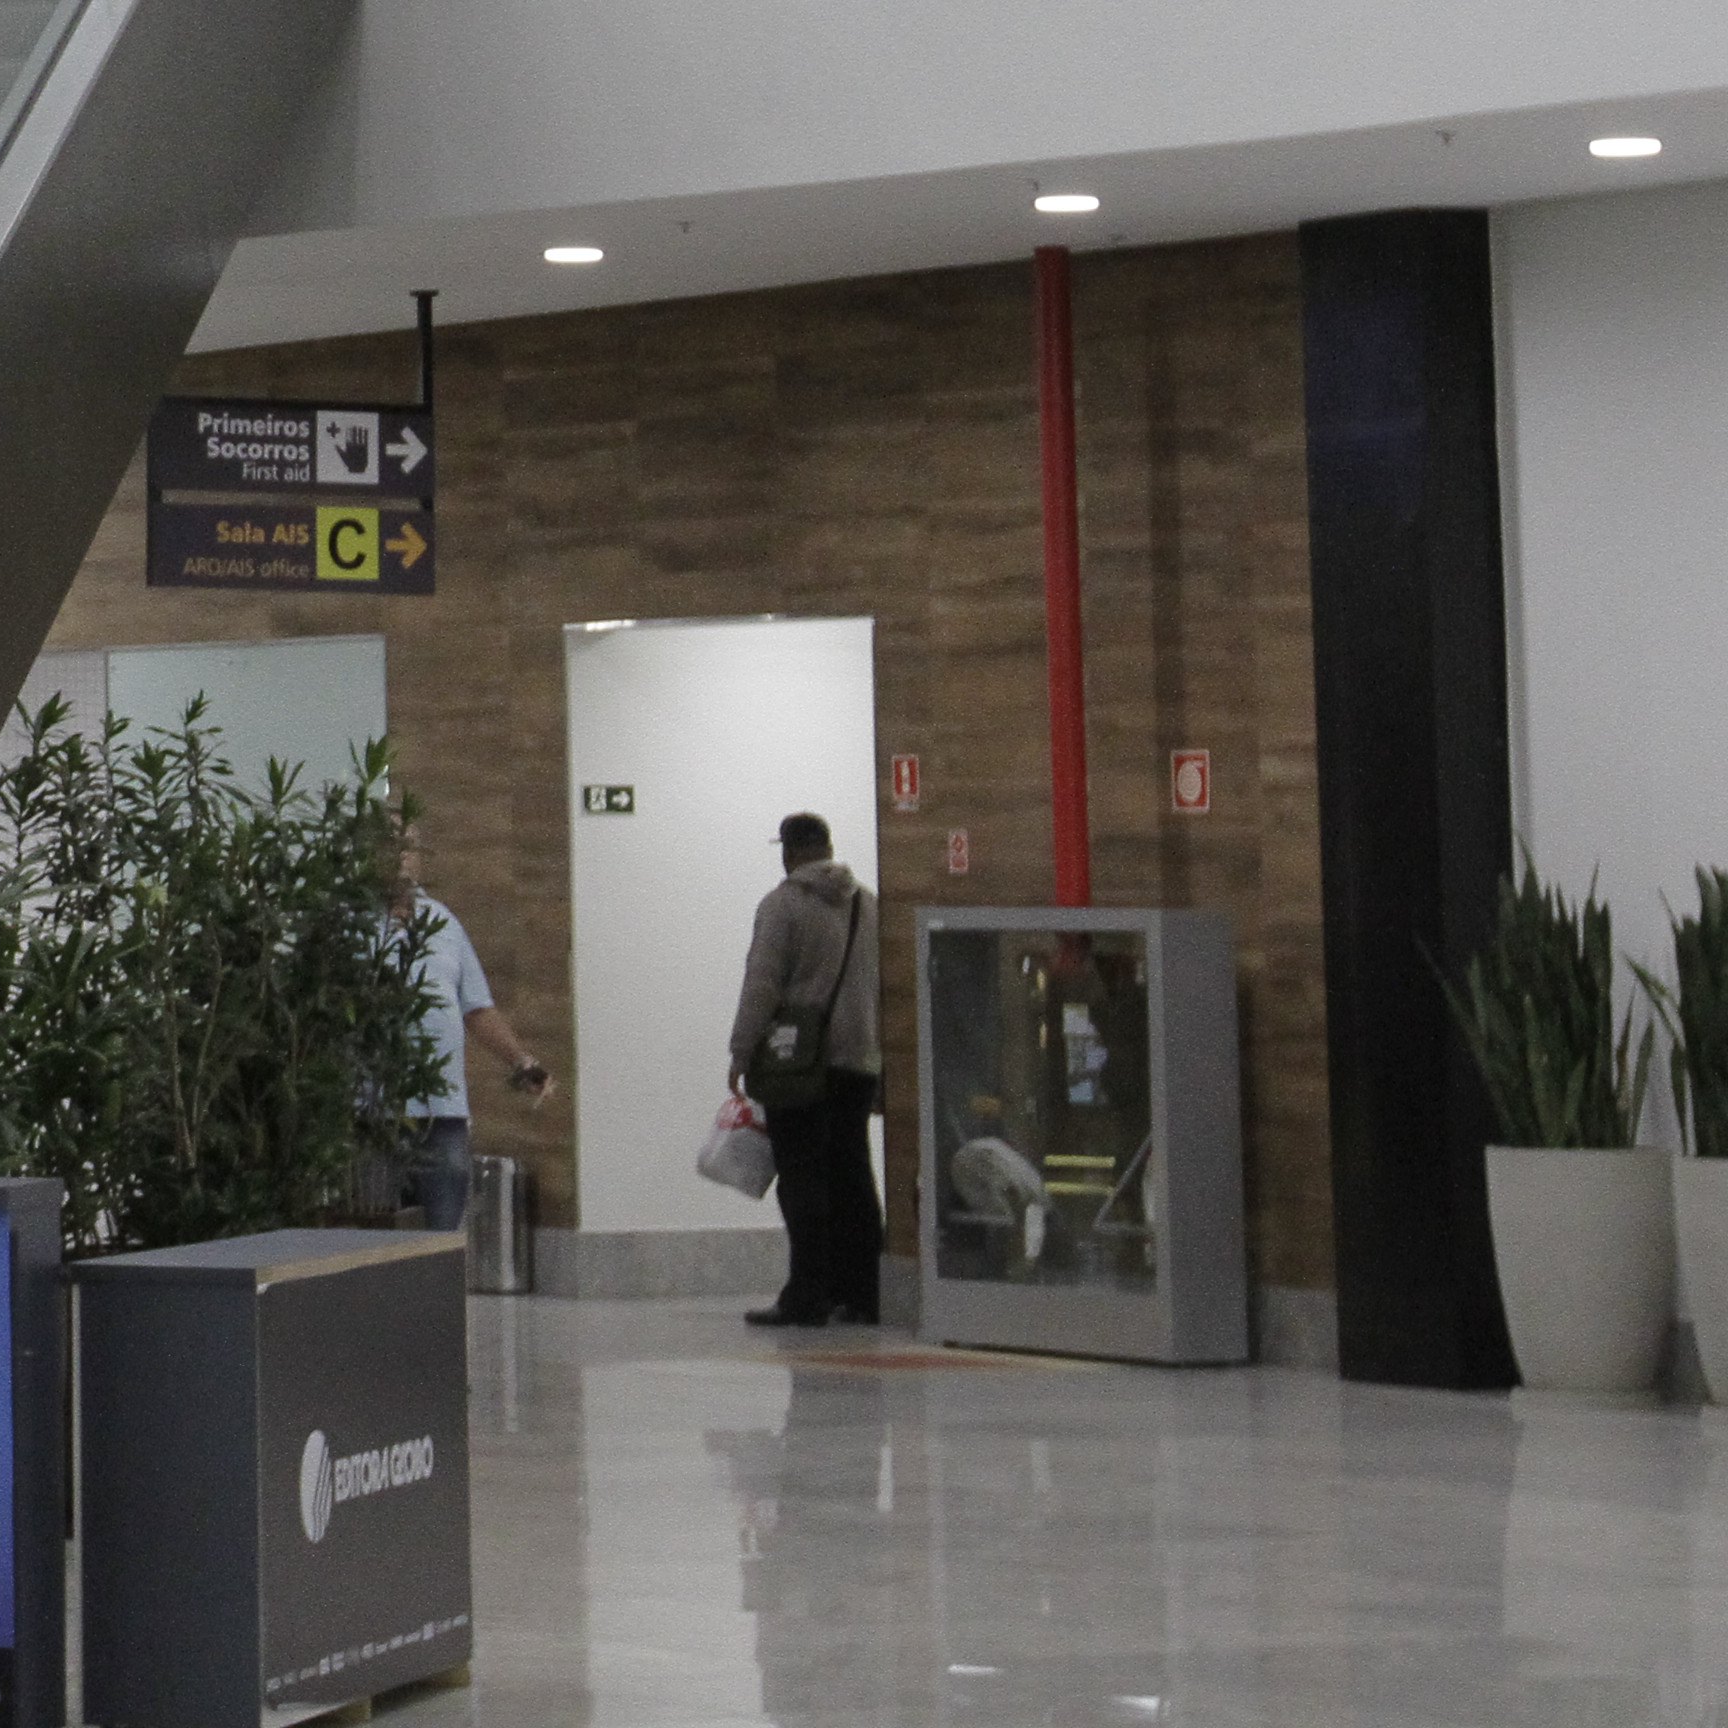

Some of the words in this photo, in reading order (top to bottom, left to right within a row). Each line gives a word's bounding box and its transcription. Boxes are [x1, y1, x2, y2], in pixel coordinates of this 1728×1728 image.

[197, 412, 310, 438] Primeiros
[206, 437, 310, 461] Socorros
[242, 464, 278, 481] First
[284, 465, 310, 482] aid
[216, 521, 266, 544] Sala
[272, 524, 310, 545] AIS
[328, 518, 366, 570] C
